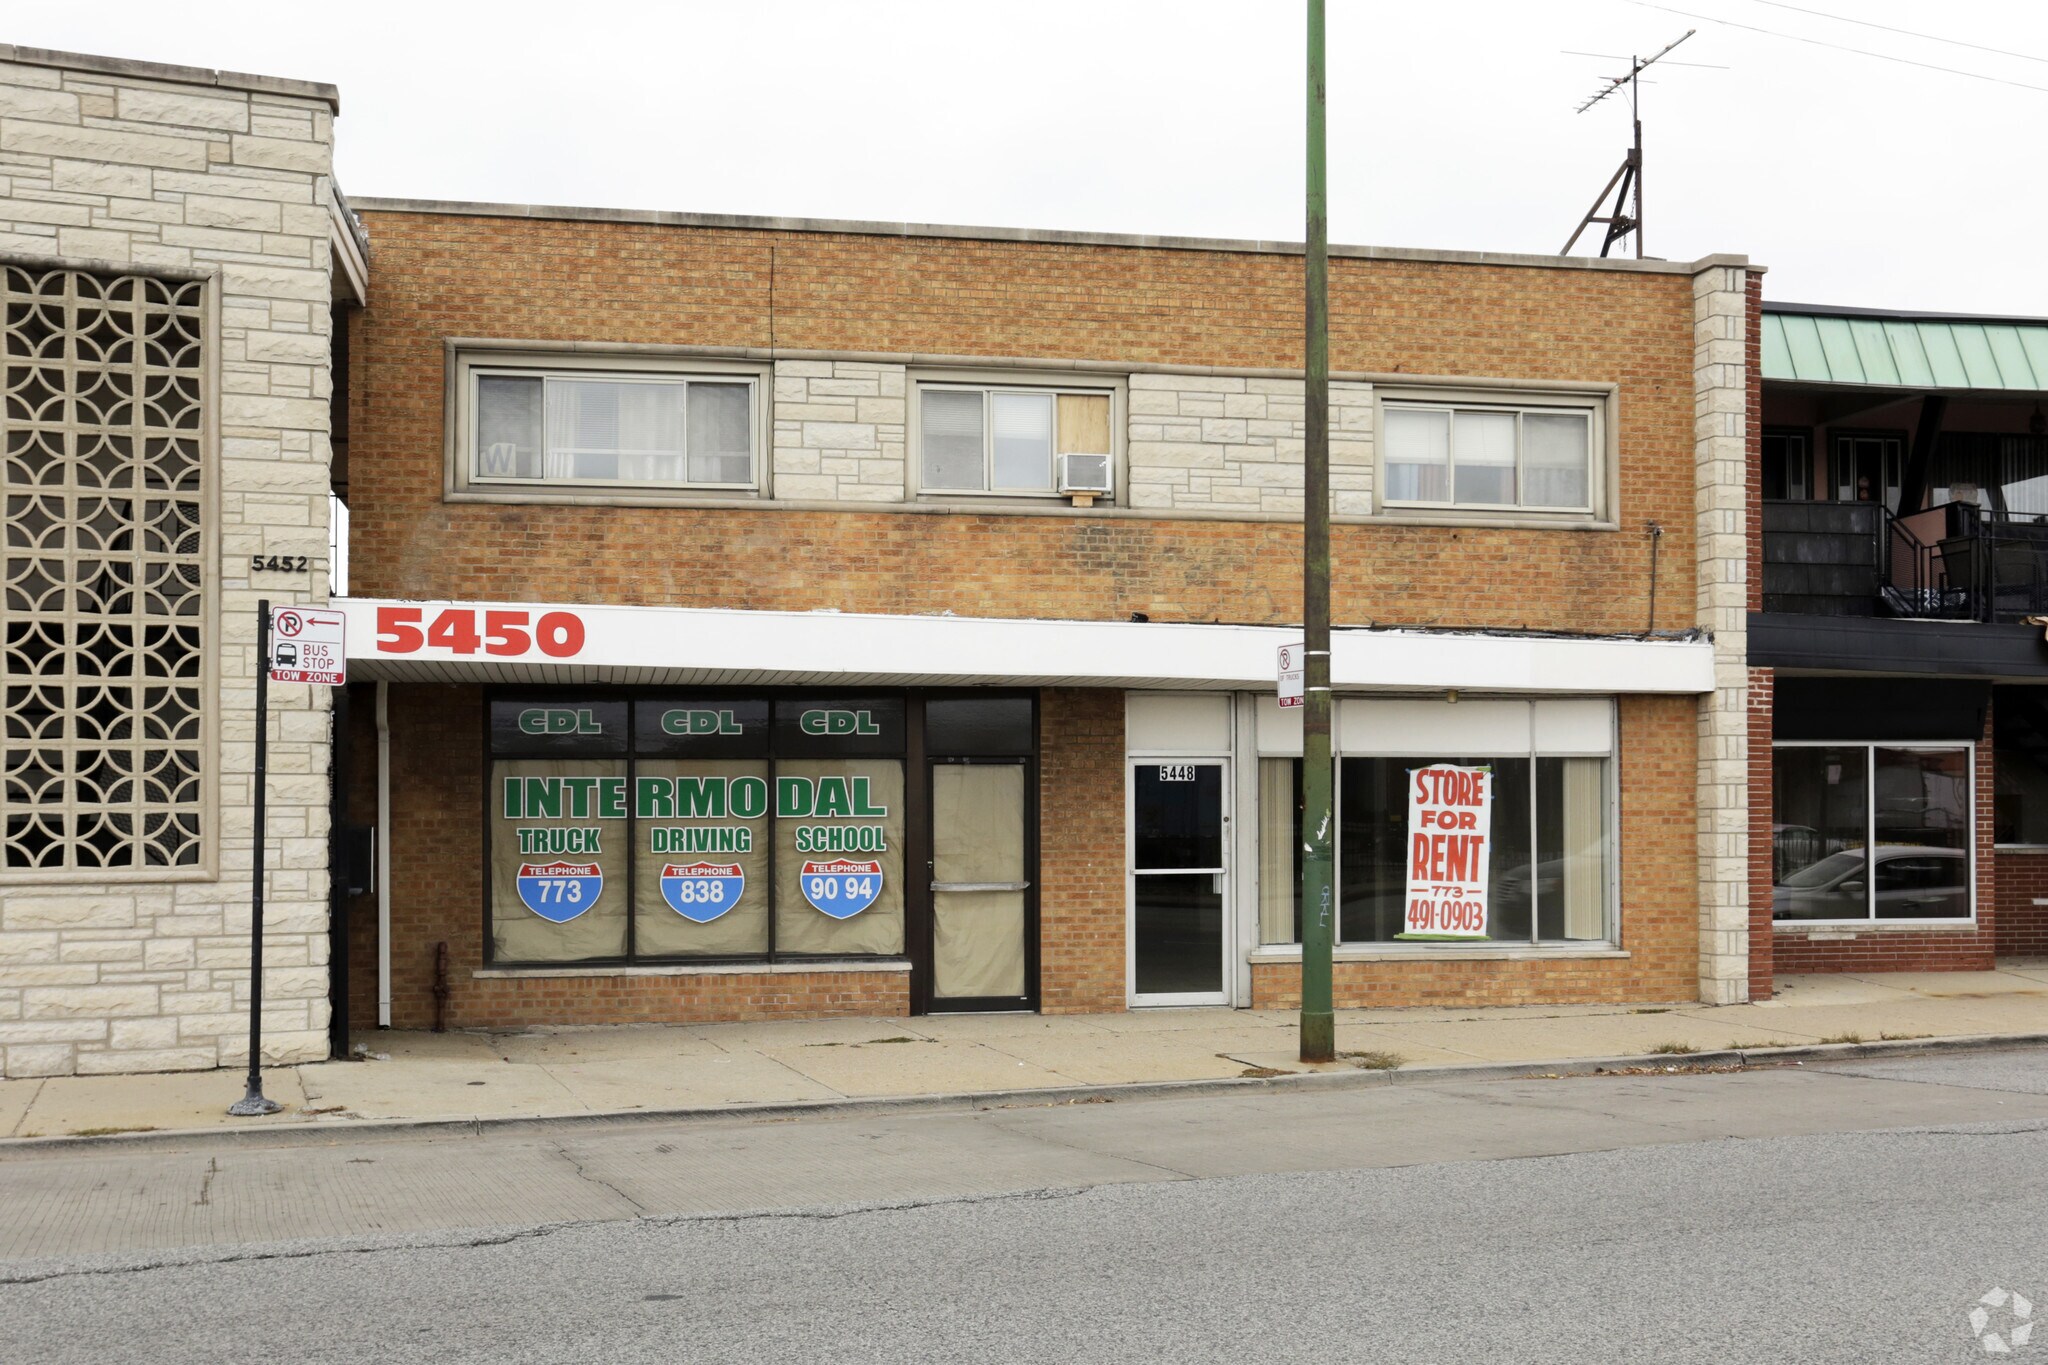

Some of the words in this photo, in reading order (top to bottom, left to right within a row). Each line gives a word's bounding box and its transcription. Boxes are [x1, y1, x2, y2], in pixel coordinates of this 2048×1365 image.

[252, 555, 308, 573] 5452
[376, 606, 586, 658] 5450
[303, 644, 329, 657] BUS
[302, 657, 335, 670] STOP
[275, 670, 300, 681] TOW
[306, 672, 338, 683] ZONE
[1281, 698, 1292, 706] TOW
[1293, 697, 1304, 705] ZON
[518, 708, 602, 735] CDL
[660, 709, 743, 735] CDL
[799, 709, 880, 735] CDL
[1161, 766, 1194, 780] 5448
[1416, 769, 1484, 806] STORE
[1421, 810, 1477, 830] FOR
[516, 827, 602, 854] TRUCK
[651, 826, 752, 853] DRIVING
[795, 825, 887, 852] SCHOOL
[1412, 833, 1485, 882] RENT
[528, 866, 592, 876] TELEPHONE
[671, 866, 734, 877] TELEPHONE
[811, 863, 873, 874] TELEPHONE
[538, 880, 582, 903] 773
[680, 880, 724, 903] 838
[810, 877, 838, 900] 90
[845, 877, 873, 900] 94
[1407, 899, 1484, 931] 491-0903
